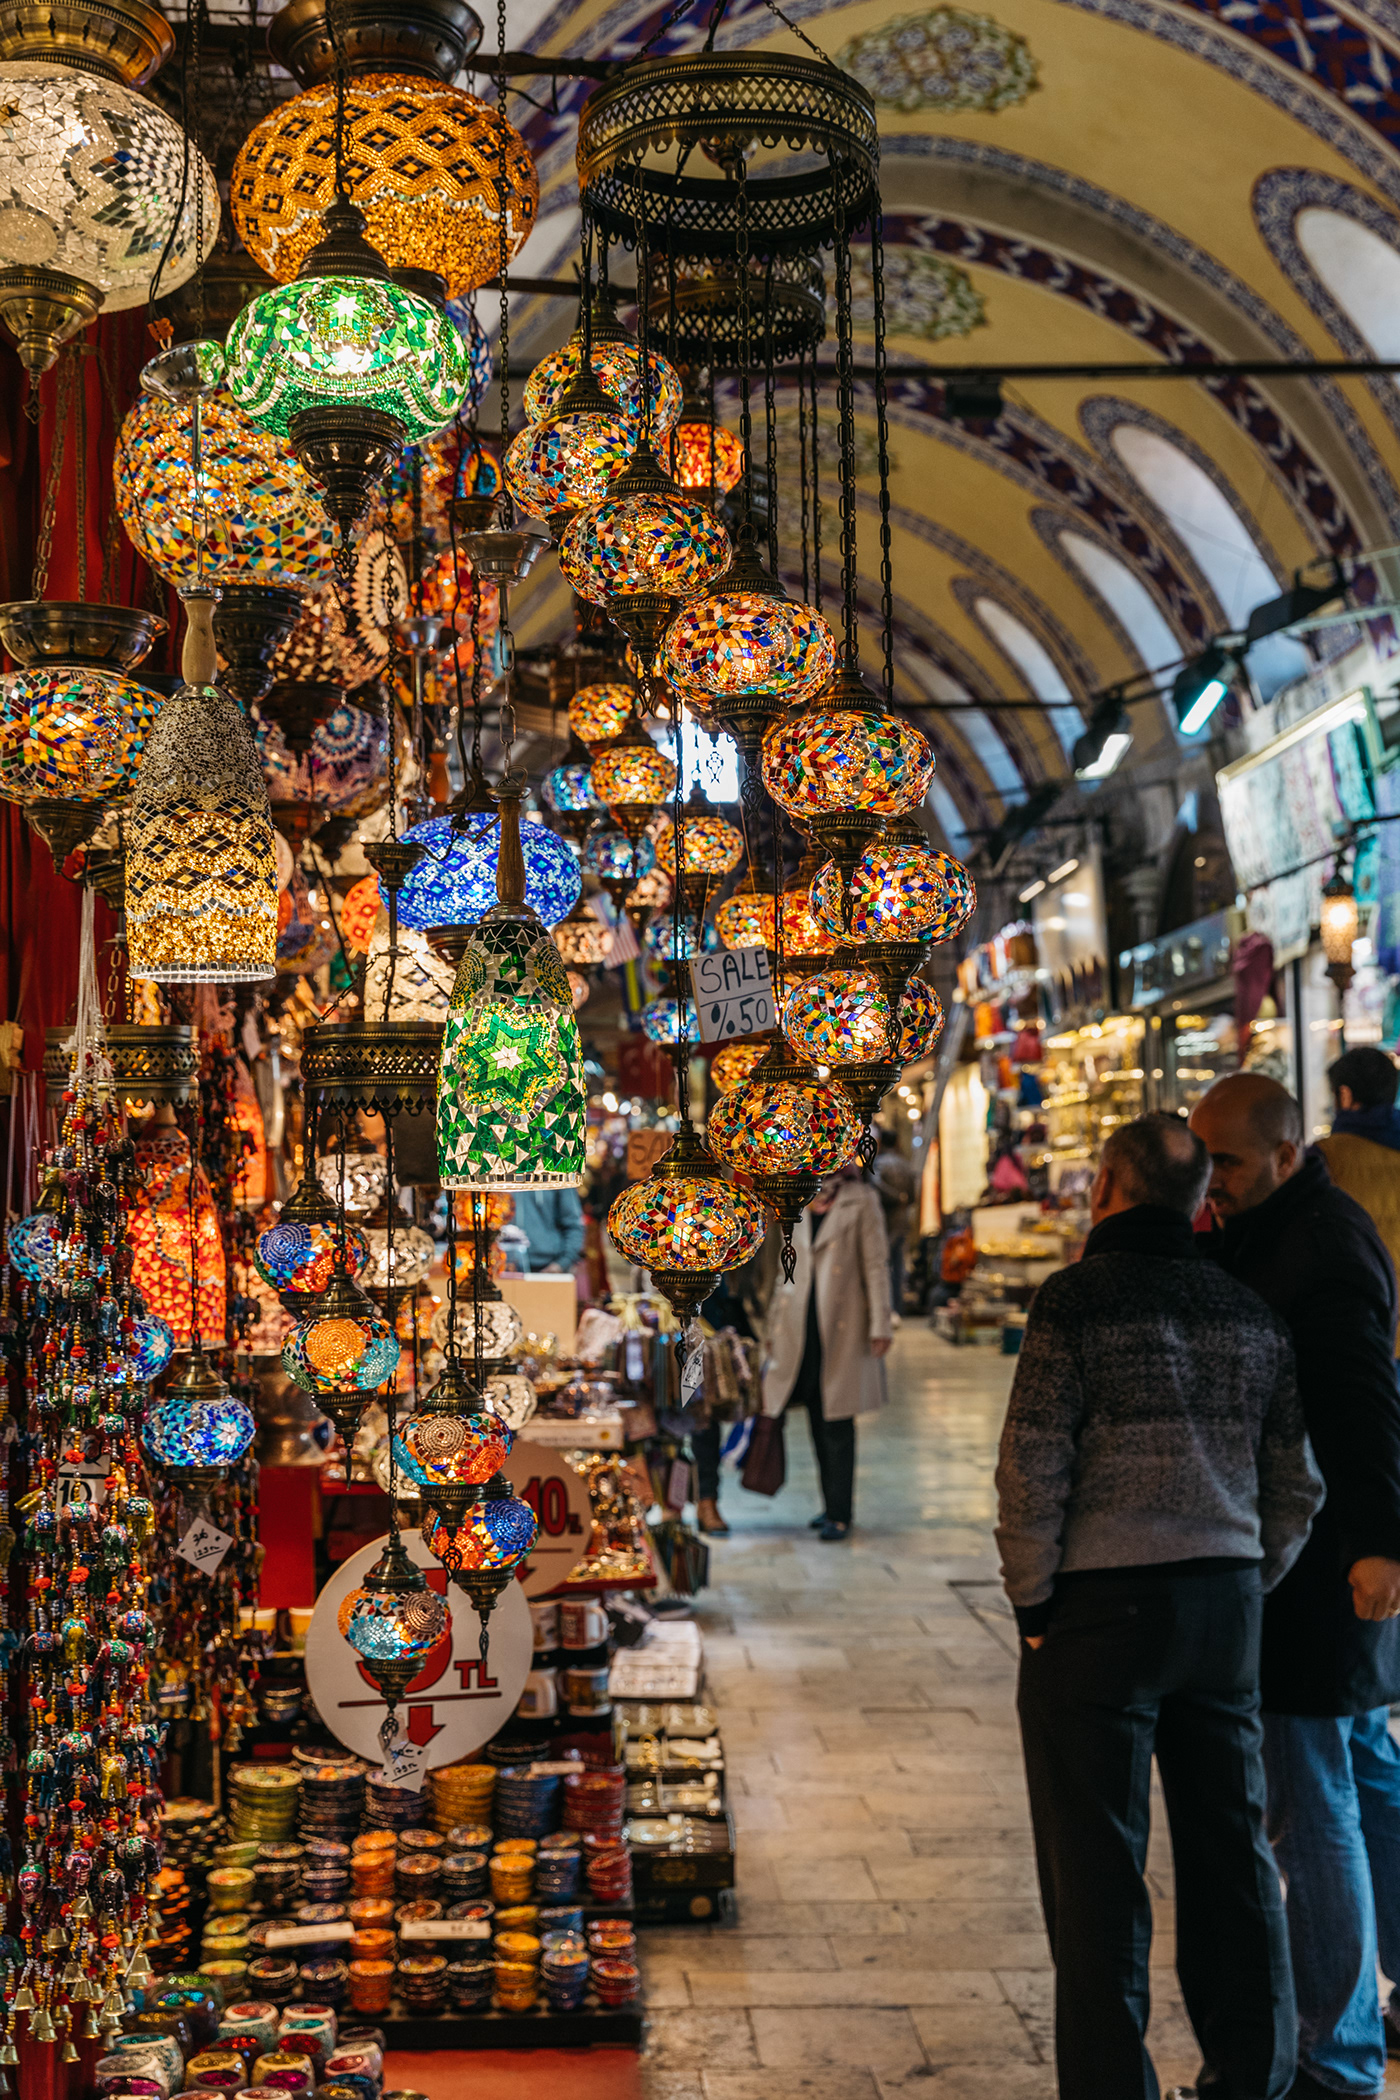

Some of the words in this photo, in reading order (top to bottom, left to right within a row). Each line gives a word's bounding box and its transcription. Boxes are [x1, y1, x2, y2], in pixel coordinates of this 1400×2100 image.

[700, 950, 770, 994] SALE
[711, 997, 768, 1041] %50
[520, 1475, 568, 1537] 10
[454, 1659, 498, 1690] TL
